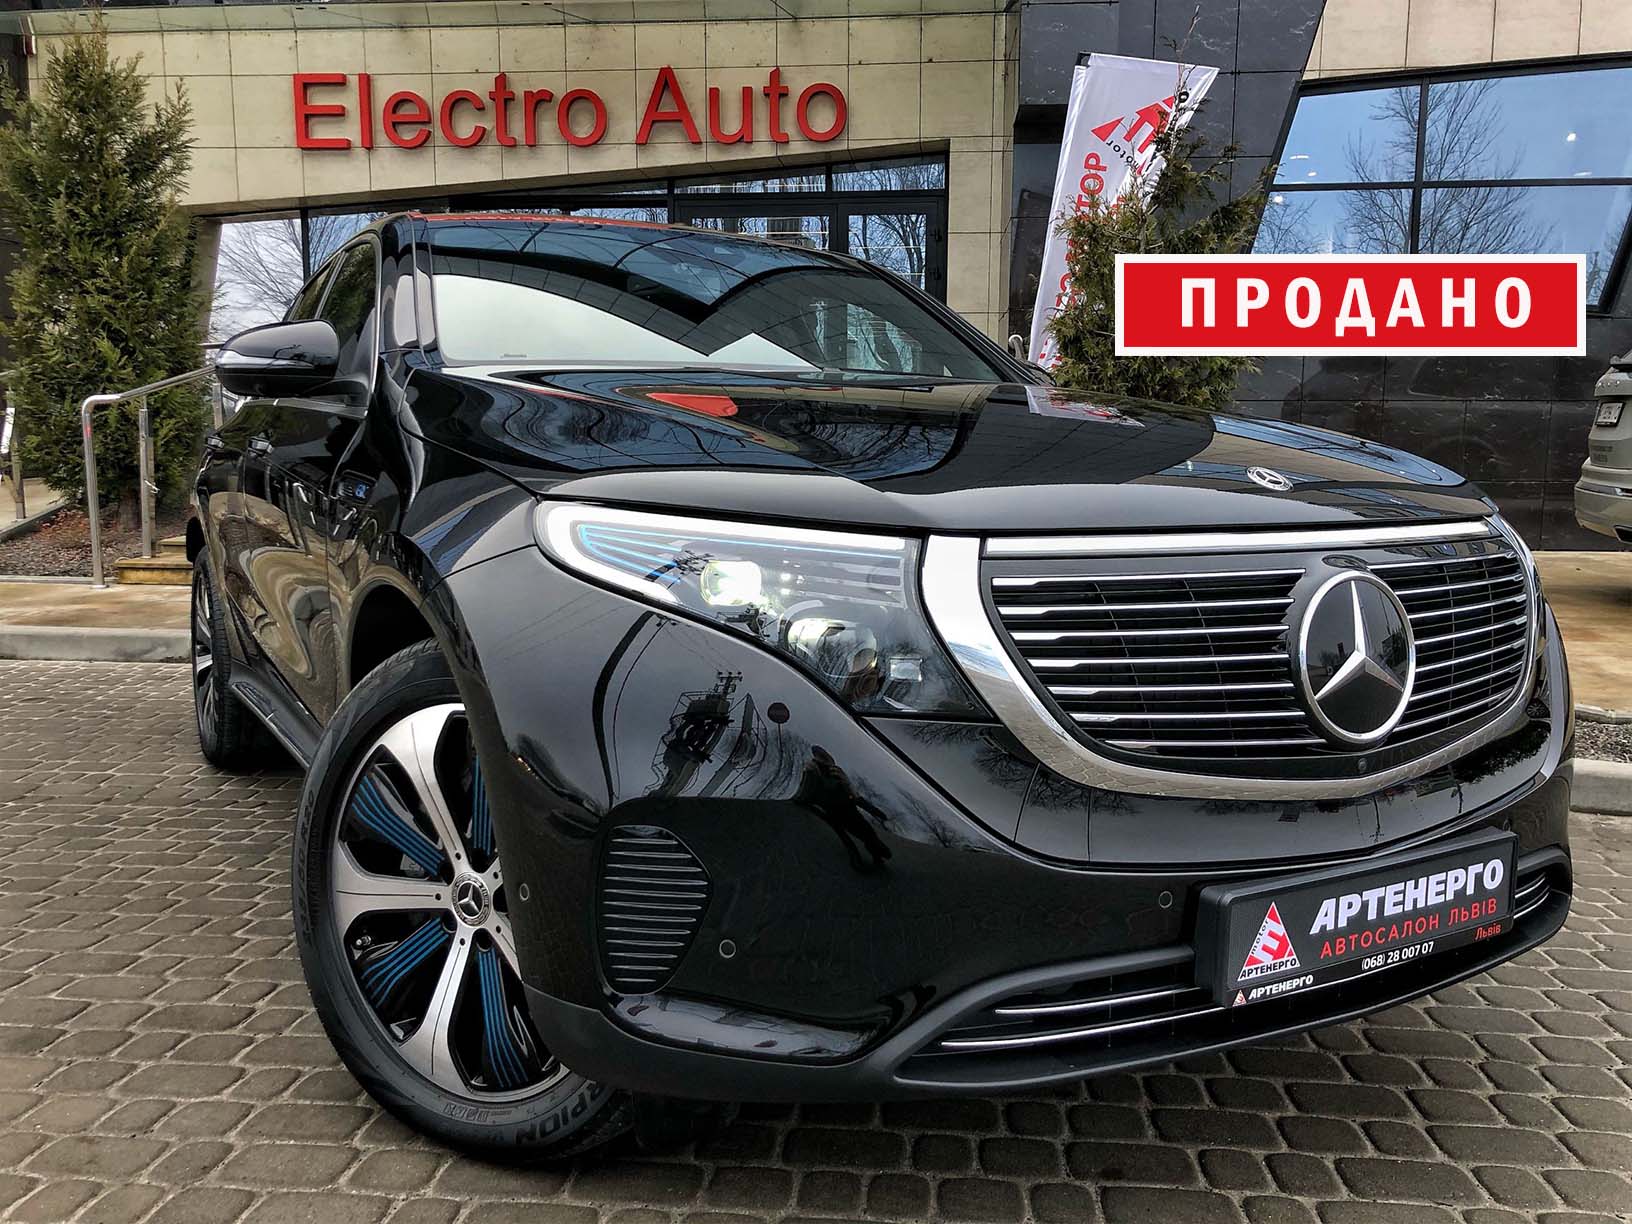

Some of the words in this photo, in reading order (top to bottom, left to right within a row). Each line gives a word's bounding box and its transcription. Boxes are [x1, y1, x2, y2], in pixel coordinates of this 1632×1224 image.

[293, 72, 607, 150] Electro
[635, 65, 848, 145] Auto
[1309, 858, 1504, 935] АРТЕНЕРГО
[1251, 919, 1269, 955] motor
[1320, 913, 1440, 959] АВТОСАЛОН
[1448, 897, 1498, 926] ЛЬВІВ
[1474, 922, 1503, 941] Львів
[1239, 958, 1297, 980] АРТЕНЕРГО
[1361, 952, 1386, 970] (068)
[1387, 950, 1399, 964] 28
[1248, 974, 1314, 1000] АРТЕНЕРГО
